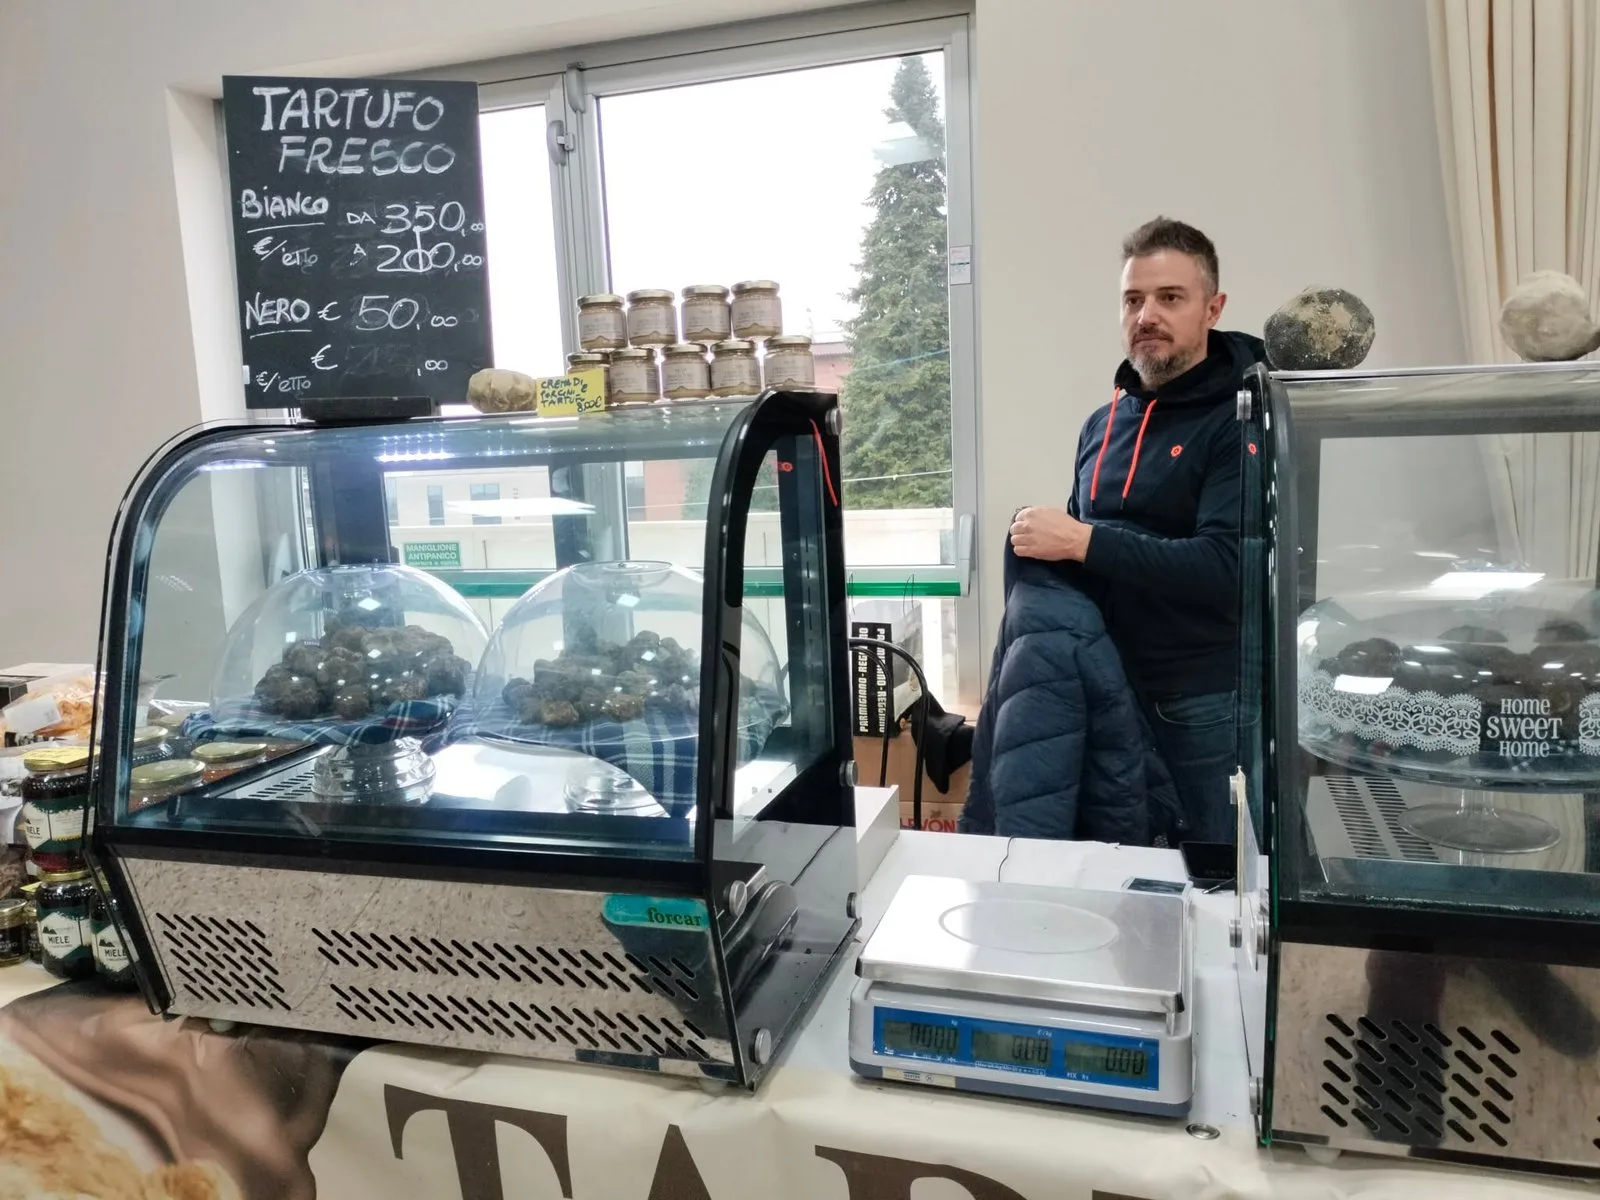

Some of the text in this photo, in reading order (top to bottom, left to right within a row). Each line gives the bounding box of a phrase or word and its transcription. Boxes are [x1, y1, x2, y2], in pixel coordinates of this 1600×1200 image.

[252, 86, 445, 131] TARTUFO
[278, 135, 456, 176] FRESCO
[346, 211, 376, 225] DA
[352, 243, 367, 256] A
[245, 292, 311, 330] NERO
[317, 301, 342, 321] €
[310, 344, 338, 370] €
[406, 543, 457, 552] MANIGLIONE
[408, 552, 457, 560] ANTIPANICO
[647, 907, 702, 926] forcar
[48, 935, 70, 945] MIELE
